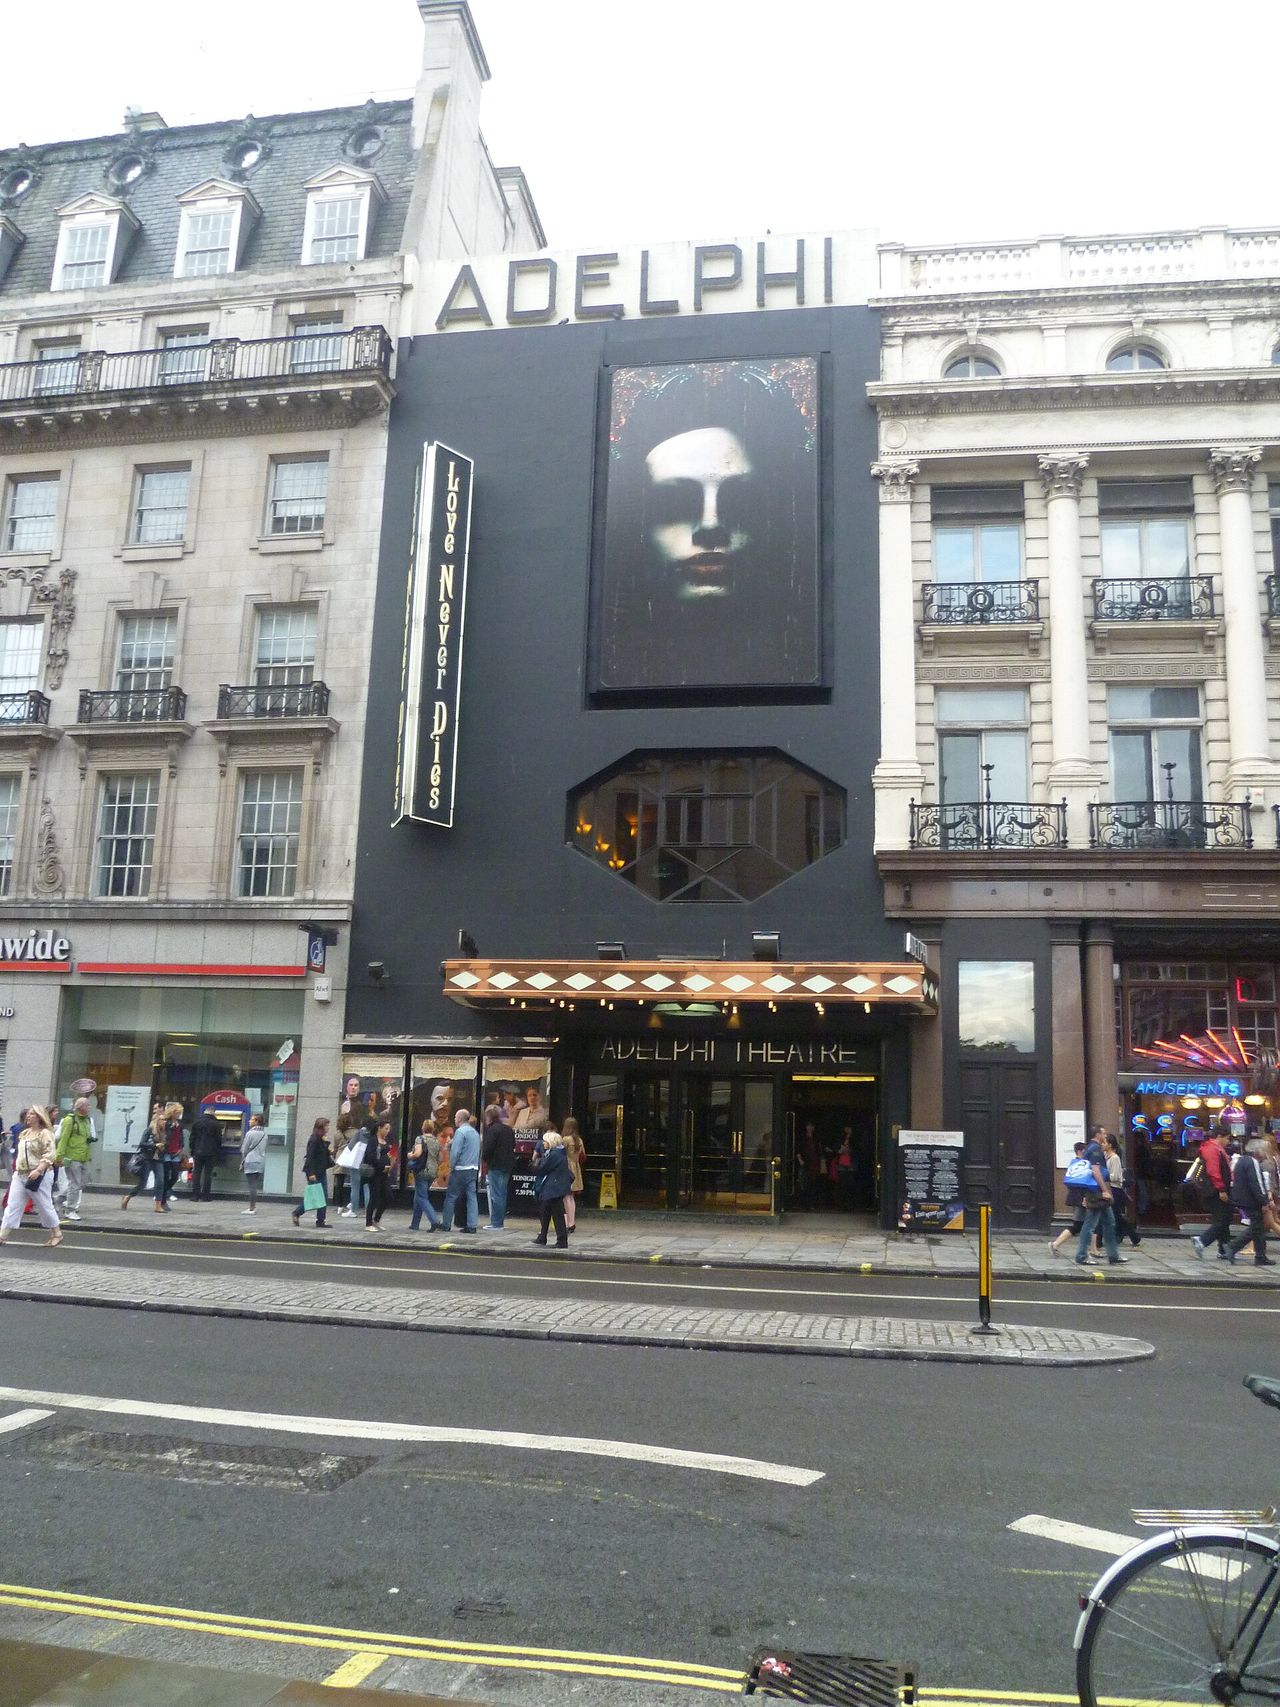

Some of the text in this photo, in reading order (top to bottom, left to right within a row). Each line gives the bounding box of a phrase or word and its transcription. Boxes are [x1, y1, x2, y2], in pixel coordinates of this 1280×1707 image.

[435, 237, 833, 330] ADELPHI
[429, 461, 459, 810] Love Never Dies
[0, 929, 70, 960] wide
[600, 1039, 857, 1064] ADELPHI THEATRE
[215, 1094, 237, 1104] Cash
[1135, 1080, 1240, 1096] AMUSEMENTS
